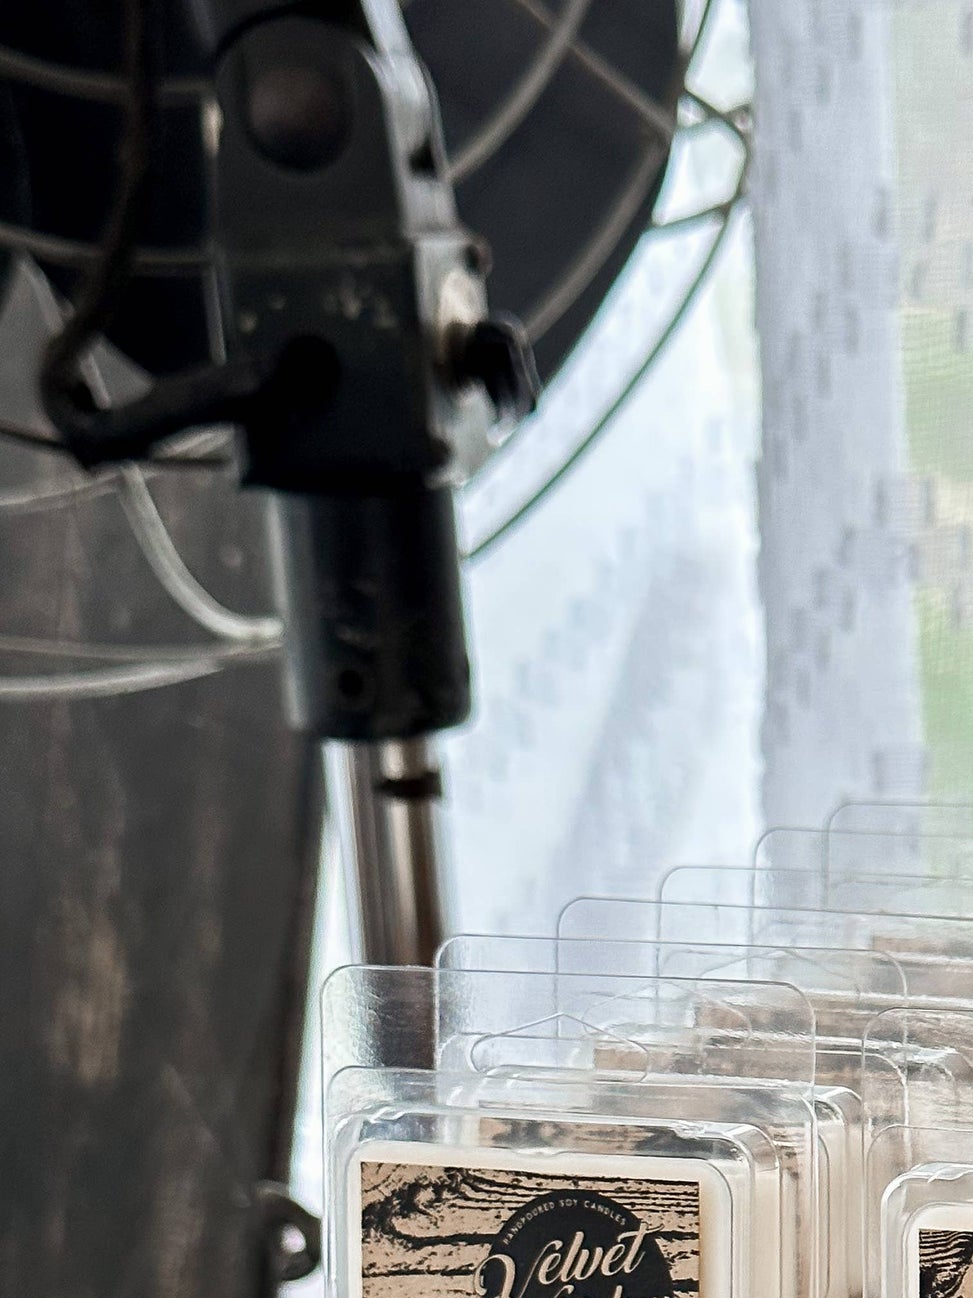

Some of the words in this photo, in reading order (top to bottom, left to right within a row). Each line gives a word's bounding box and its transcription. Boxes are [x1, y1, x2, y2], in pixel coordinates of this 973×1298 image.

[502, 1201, 555, 1245] HANDPOURED
[559, 1199, 578, 1207] SOY
[583, 1200, 627, 1227] CANDLES
